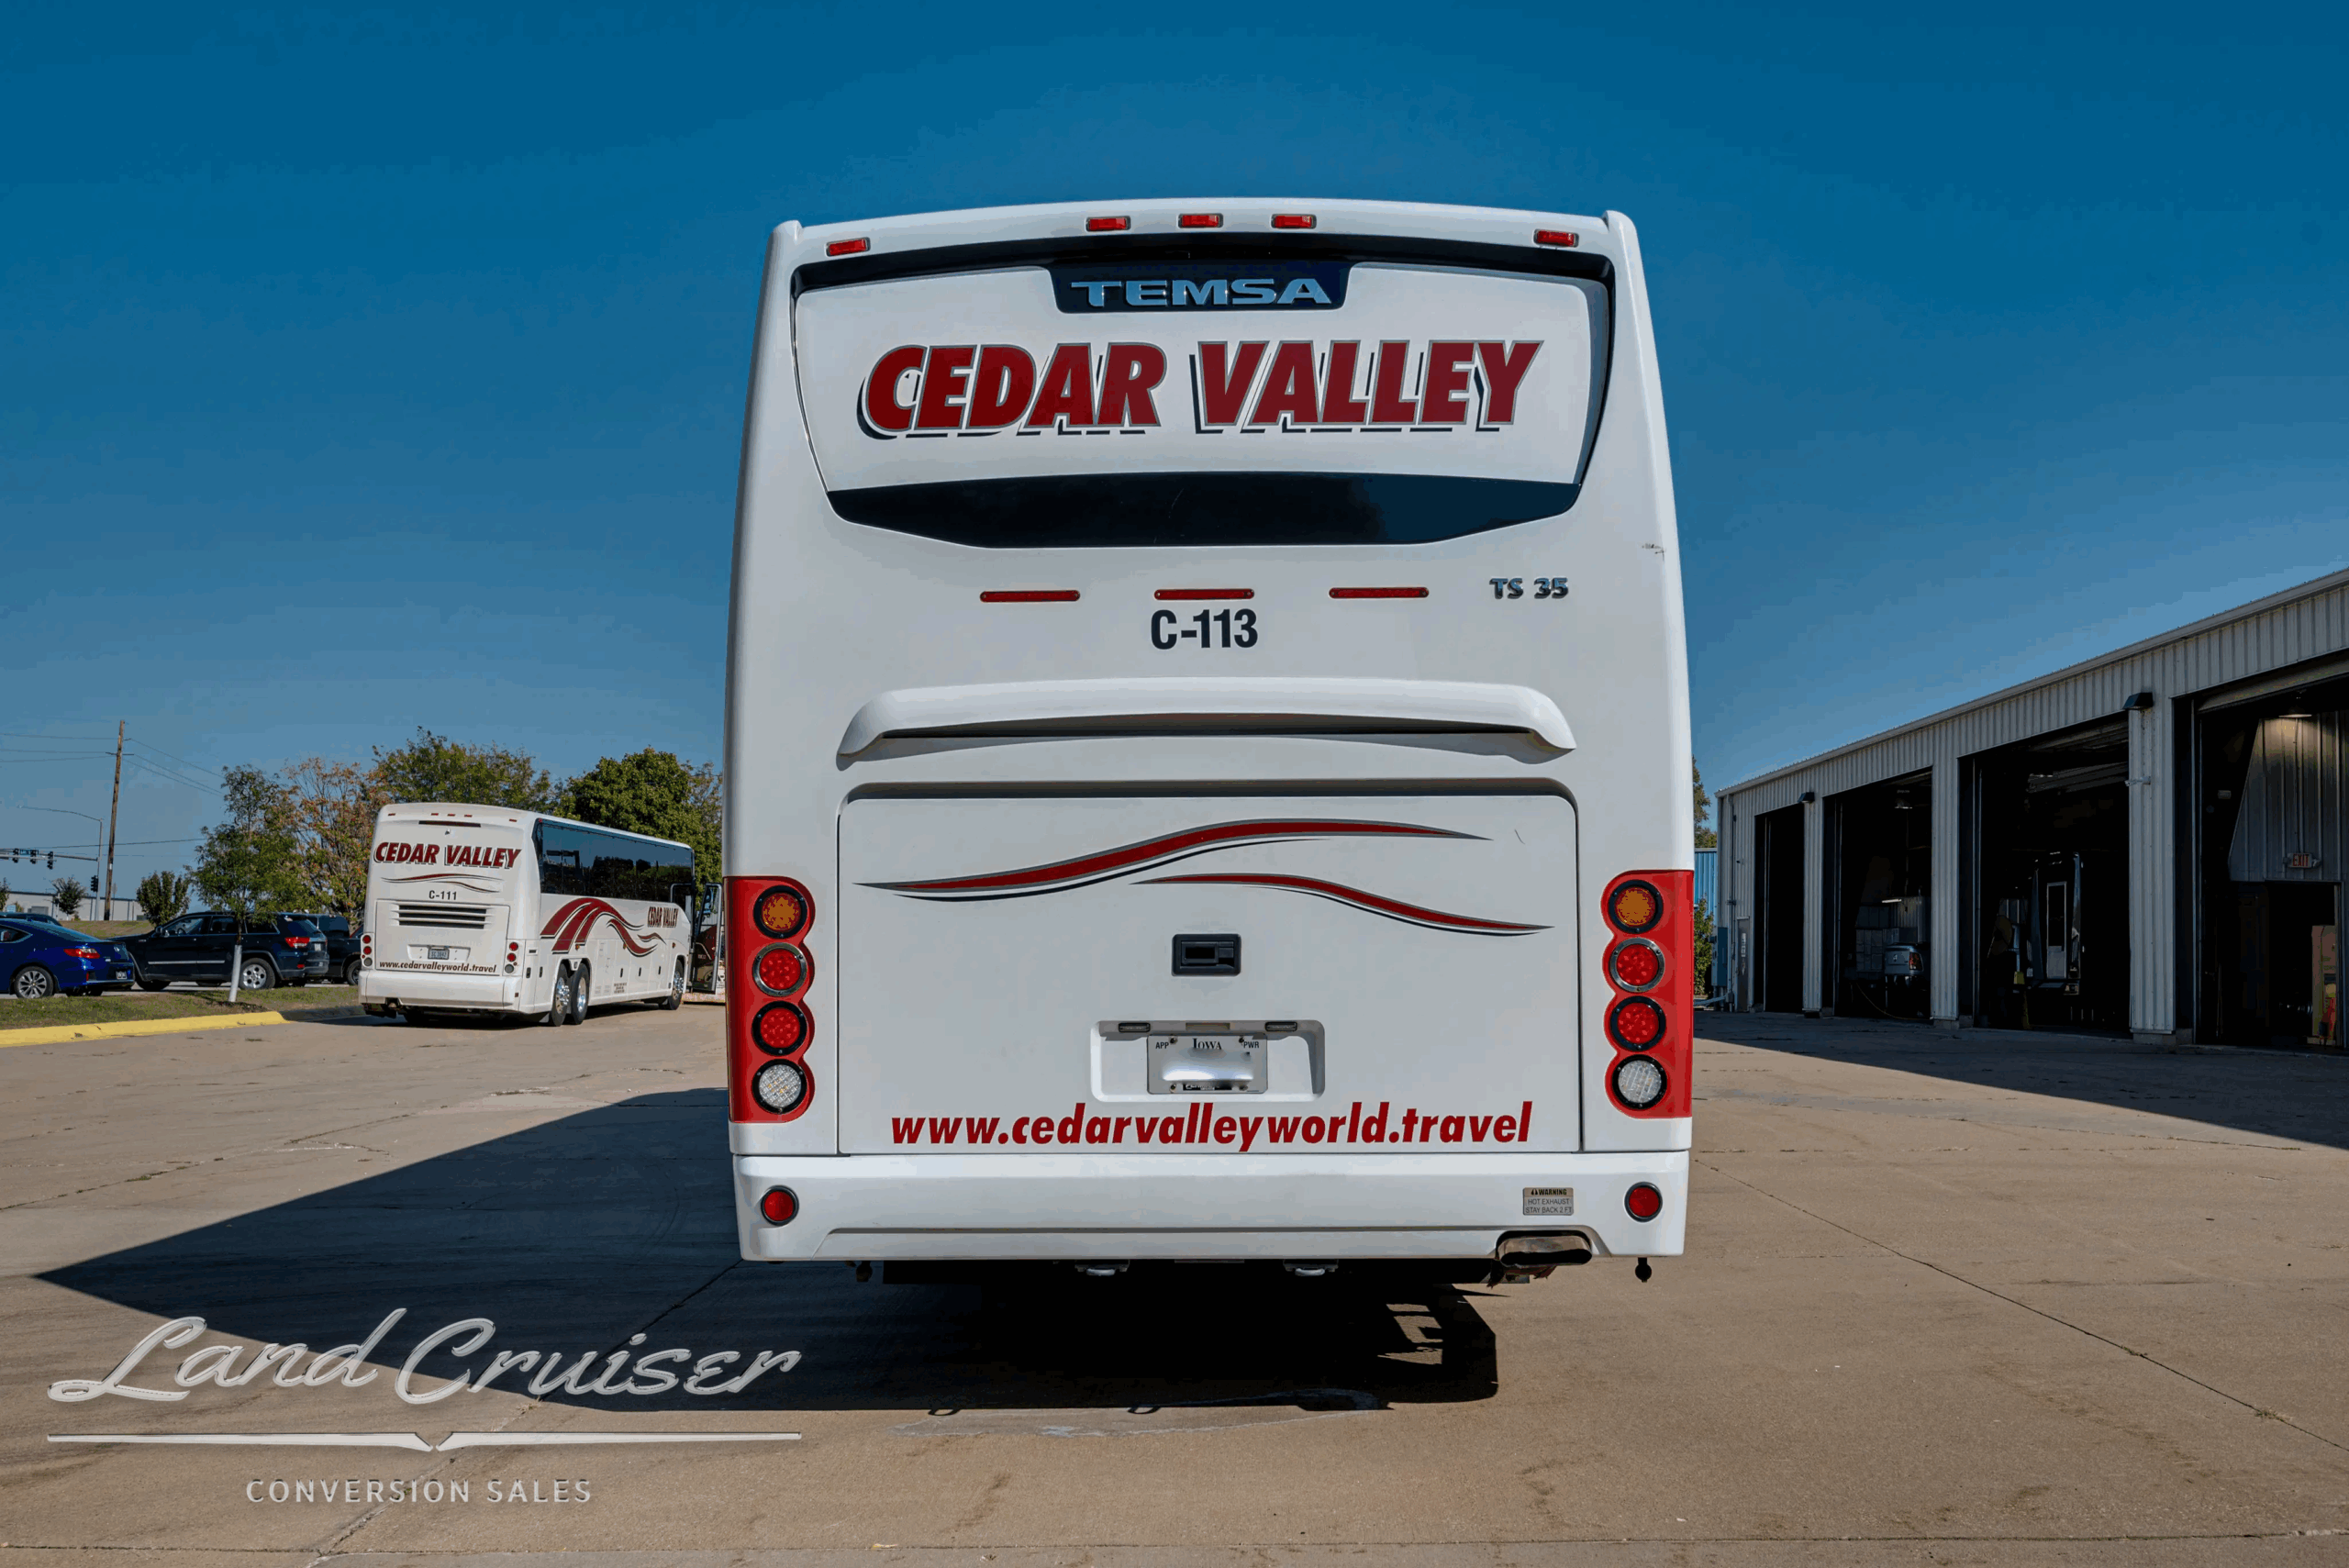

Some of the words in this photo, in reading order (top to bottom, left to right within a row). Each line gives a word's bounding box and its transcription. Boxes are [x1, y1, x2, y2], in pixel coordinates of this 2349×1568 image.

[1071, 278, 1332, 307] TEMSA
[856, 340, 1169, 439] CEDAR
[1189, 339, 1545, 435] VALLEY
[1488, 577, 1524, 600] TS
[1533, 577, 1569, 599] 35
[1151, 608, 1259, 651] C-113
[373, 841, 440, 864] CEDAR
[443, 844, 522, 869] VALLEY
[2292, 853, 2310, 867] EXIT
[428, 889, 458, 901] C-111
[379, 961, 497, 973] www.cedarvalleyworld.travel
[1154, 1041, 1170, 1050] APP
[1242, 1040, 1260, 1049] PWR
[891, 1101, 1533, 1152] www.cedarvalleyworld.travel
